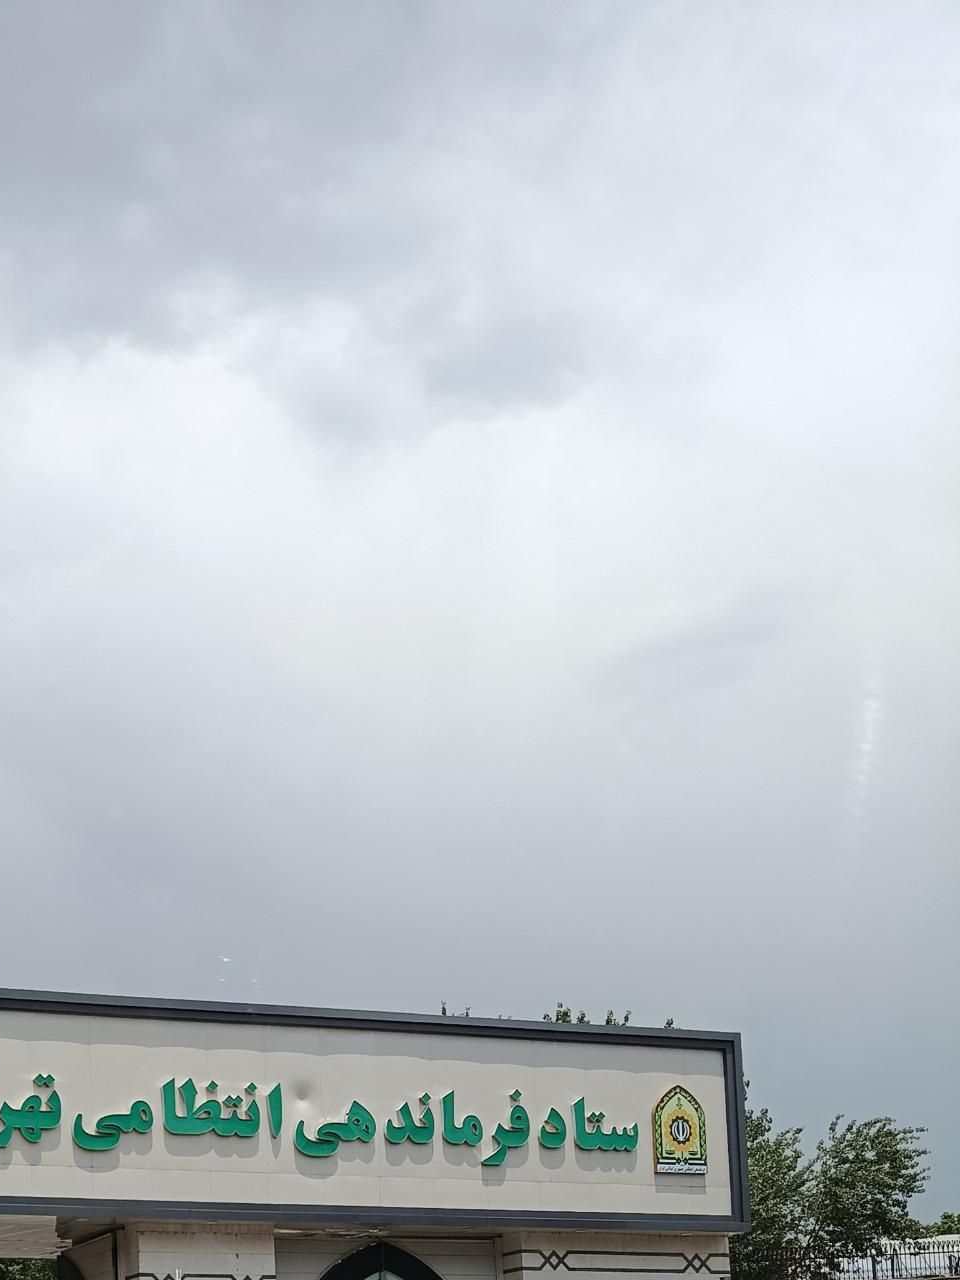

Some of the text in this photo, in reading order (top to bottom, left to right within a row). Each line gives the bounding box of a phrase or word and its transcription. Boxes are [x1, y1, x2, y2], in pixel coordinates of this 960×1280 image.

[71, 1077, 284, 1151] انتظامی
[293, 1088, 530, 1166] فرماندهی
[538, 1096, 639, 1152] ستاد
